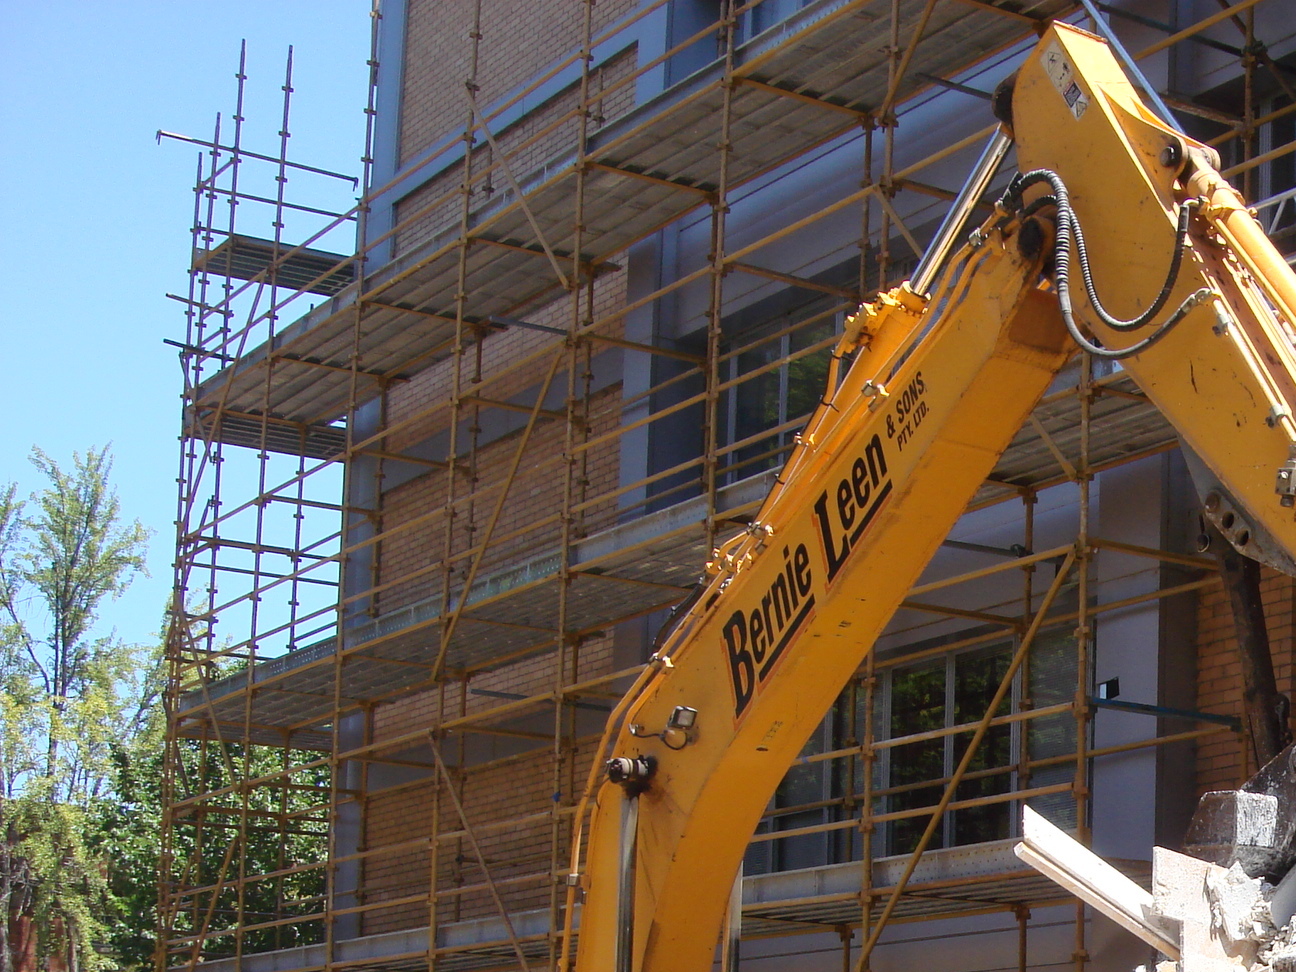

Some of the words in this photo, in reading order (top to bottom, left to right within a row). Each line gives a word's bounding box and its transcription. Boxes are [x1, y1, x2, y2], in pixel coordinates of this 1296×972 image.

[886, 413, 896, 439] &
[895, 371, 925, 424] SONS
[896, 420, 913, 452] PTY.
[913, 401, 930, 428] LTD.
[722, 543, 812, 719] Bernie
[815, 433, 888, 584] Leen
